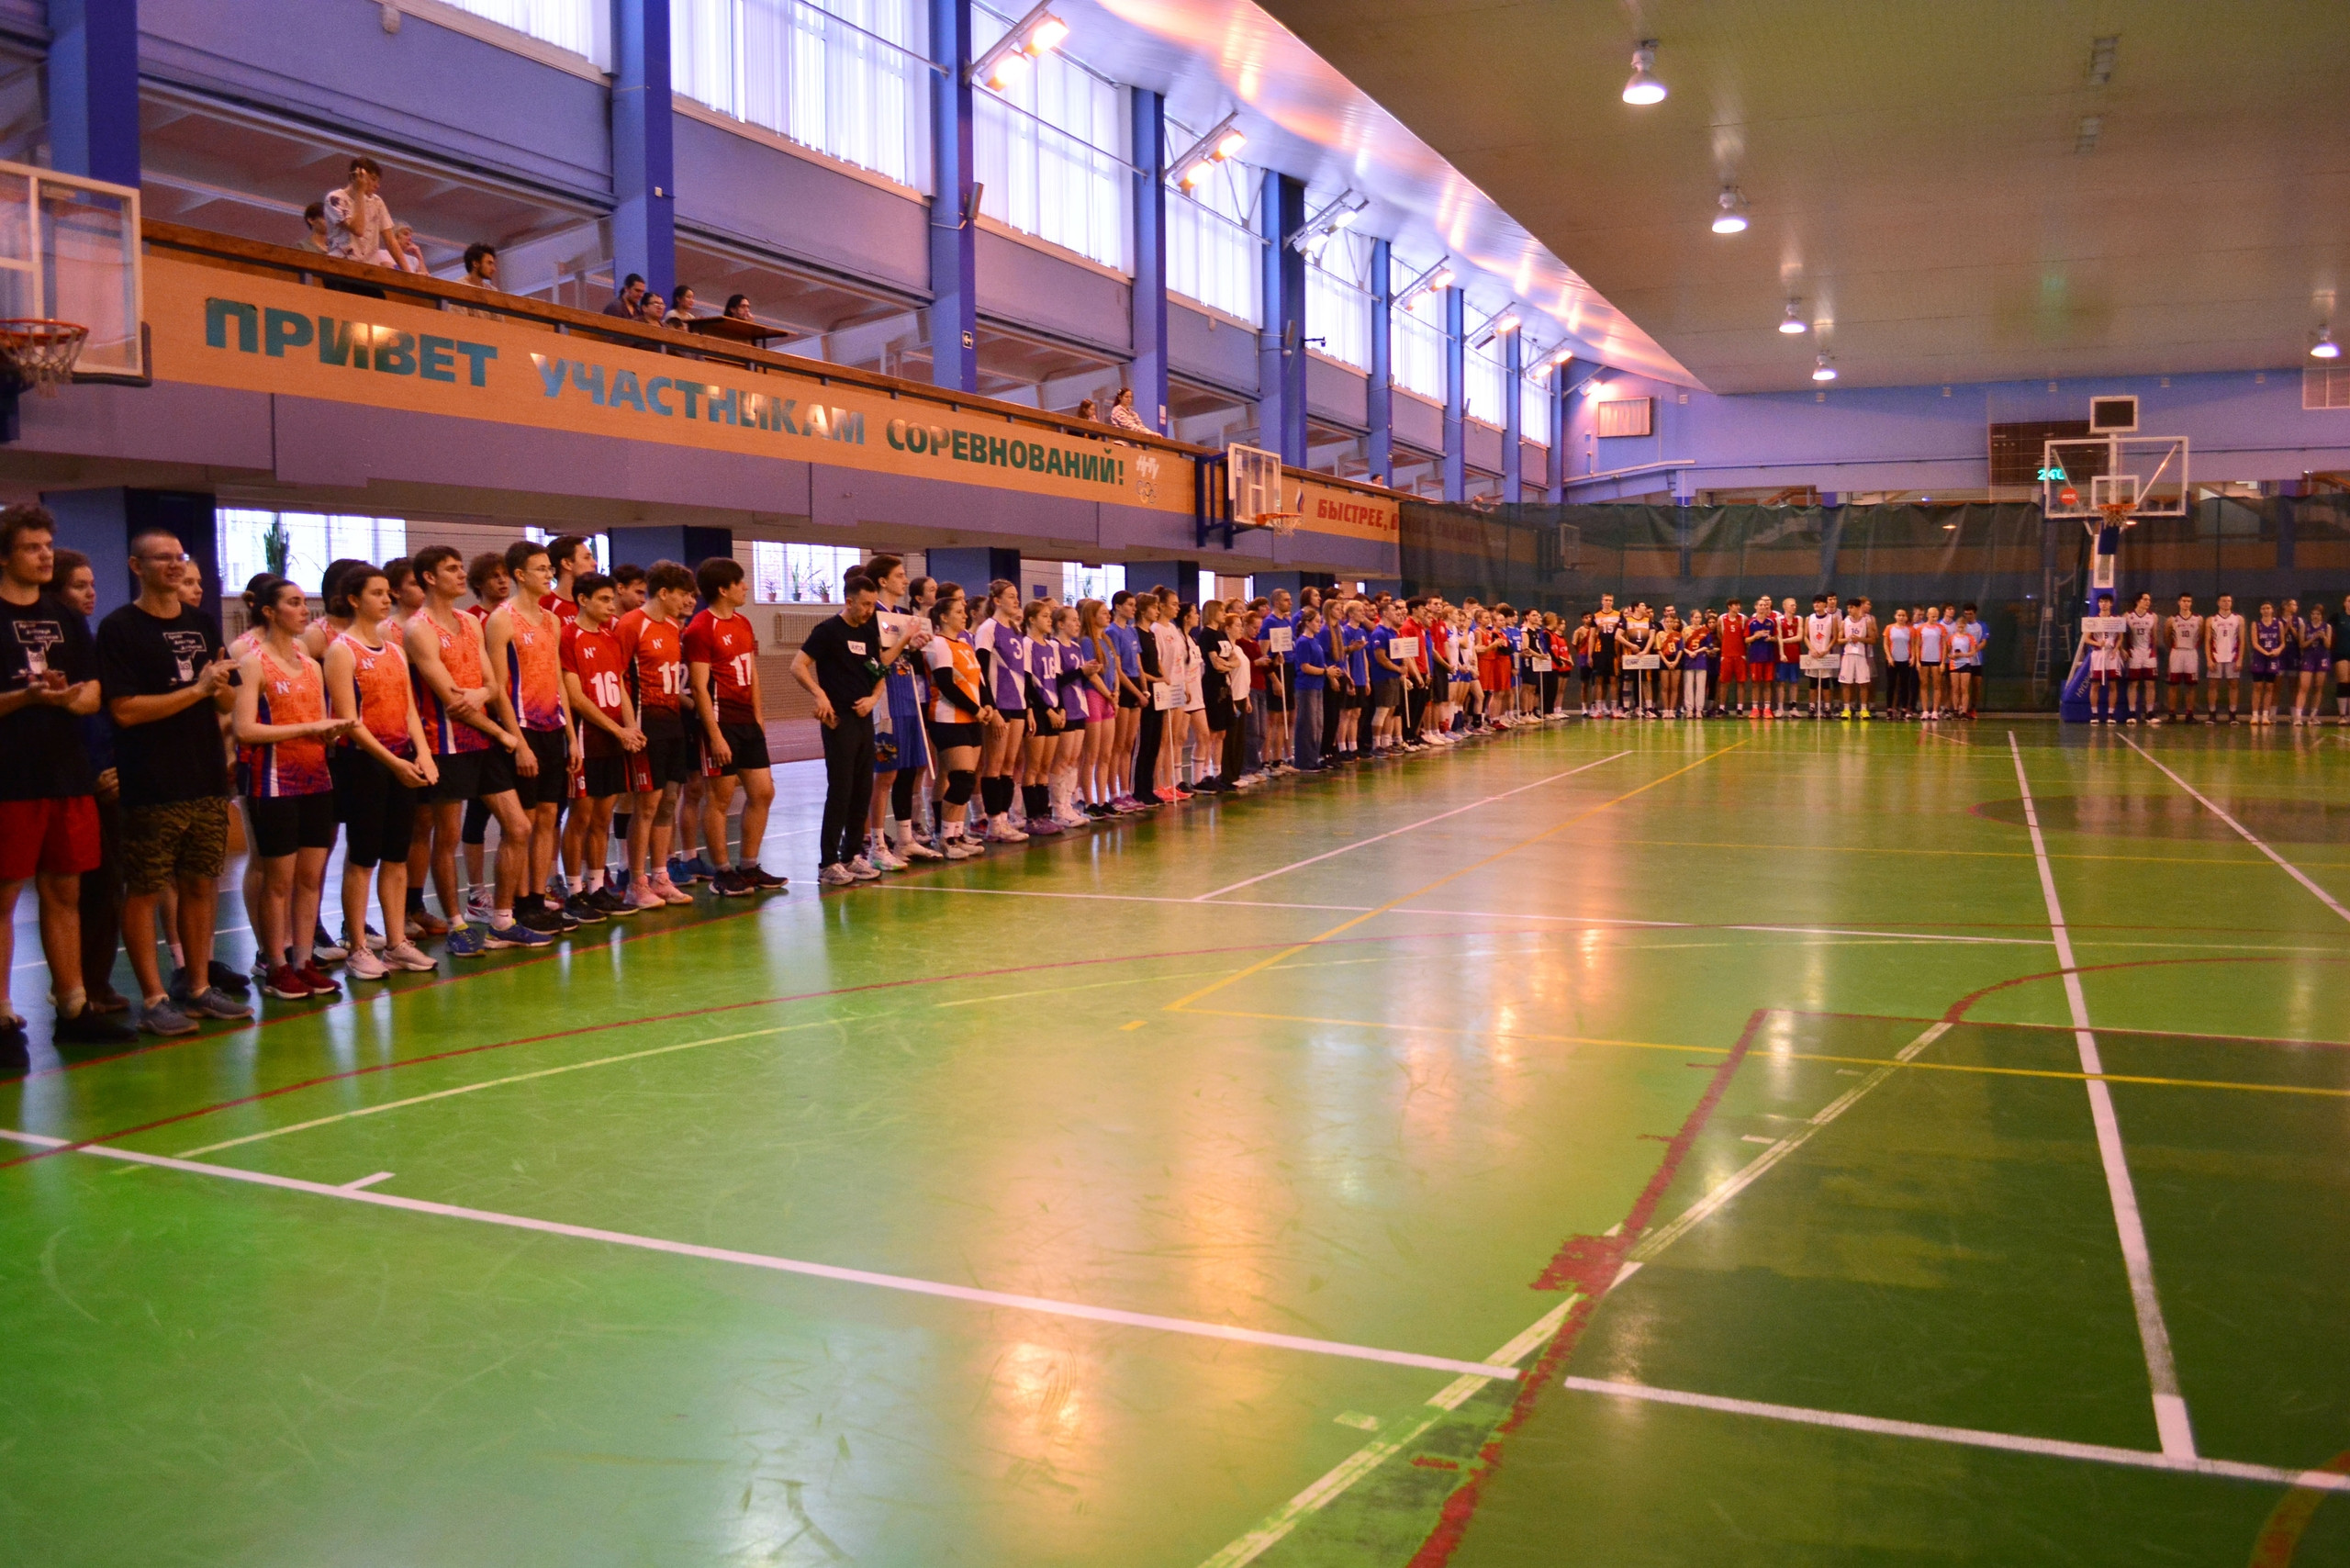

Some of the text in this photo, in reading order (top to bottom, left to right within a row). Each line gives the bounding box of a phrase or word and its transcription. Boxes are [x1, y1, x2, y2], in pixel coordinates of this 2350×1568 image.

[205, 297, 1125, 486] ПРИВЕТ УЧАСТНИКАМ СОРЕВНОВАНИЙ!
[1317, 498, 1388, 531] БЫСТРЕЕ,
[1010, 637, 1024, 659] 3
[657, 661, 680, 695] 11
[730, 652, 753, 687] 17
[590, 670, 621, 708] 16
